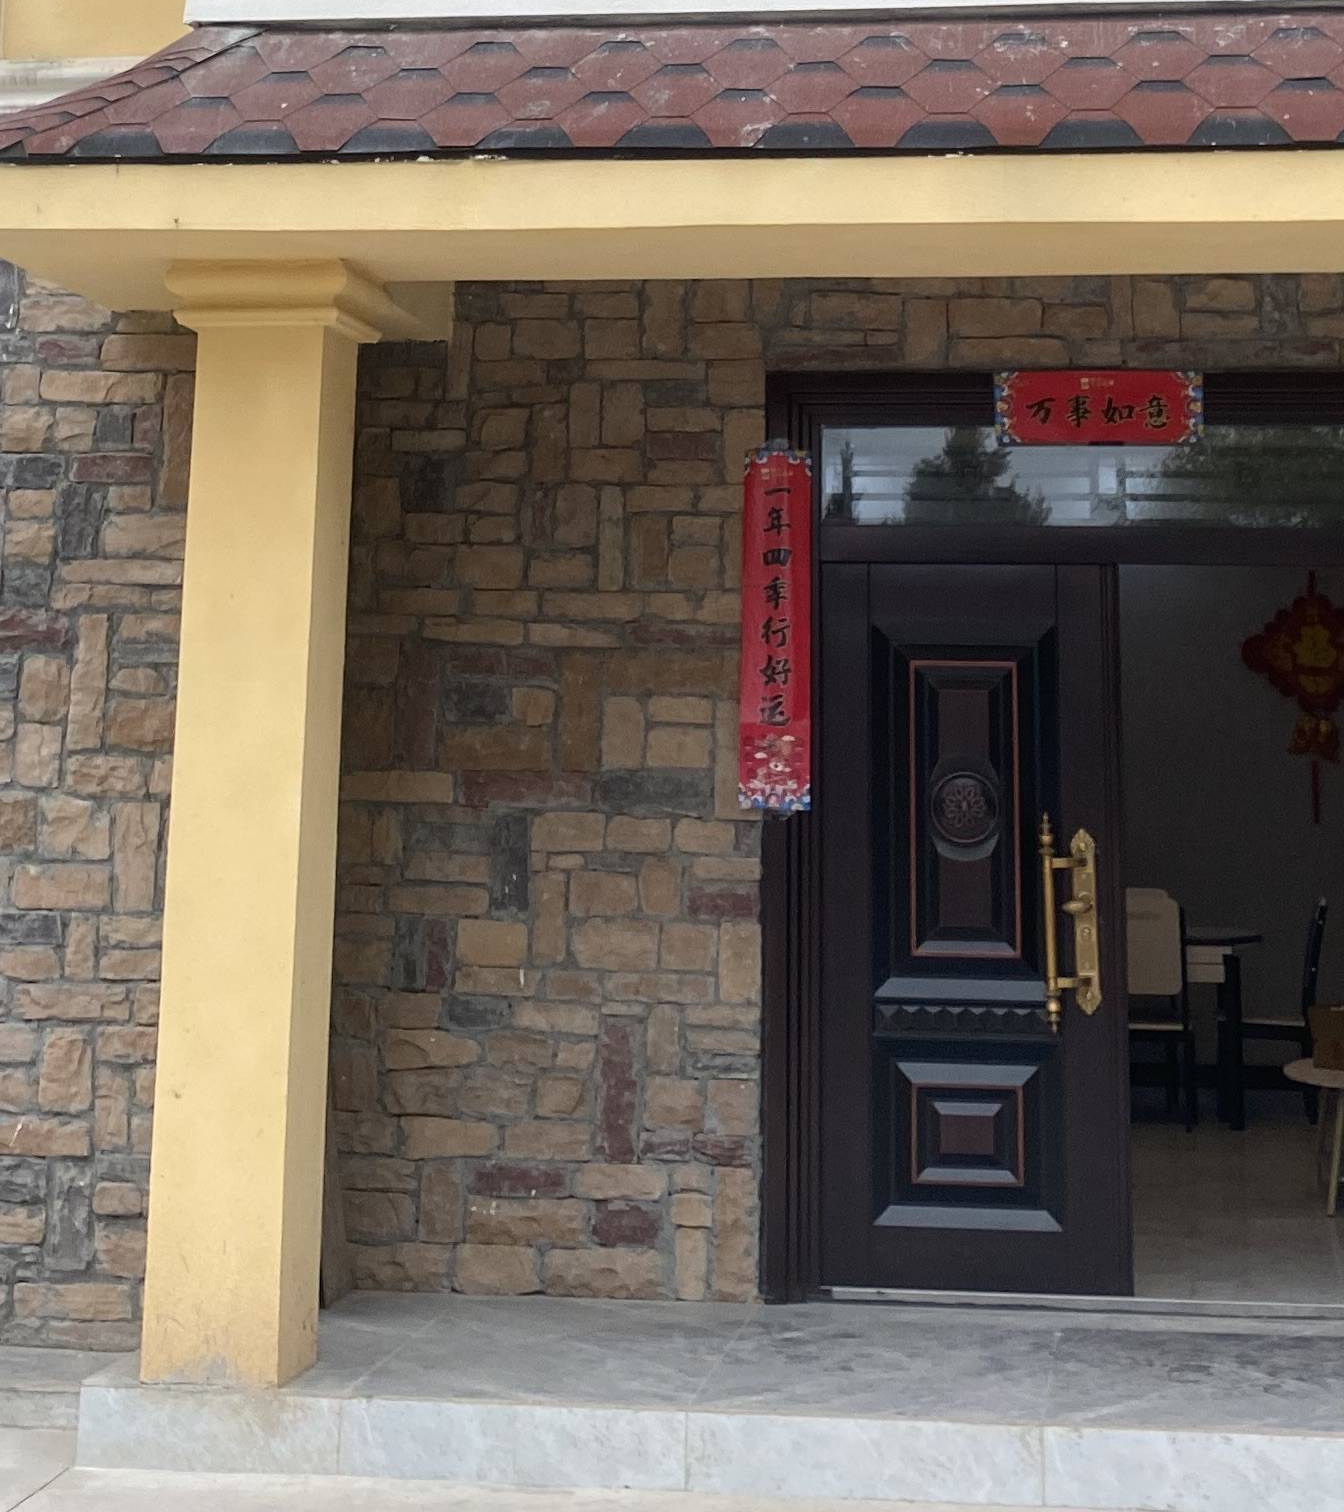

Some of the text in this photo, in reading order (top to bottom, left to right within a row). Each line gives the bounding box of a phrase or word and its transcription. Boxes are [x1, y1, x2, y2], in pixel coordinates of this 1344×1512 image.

[1025, 395, 1171, 429] 万事如意
[758, 485, 793, 728] 一年四季行好运
